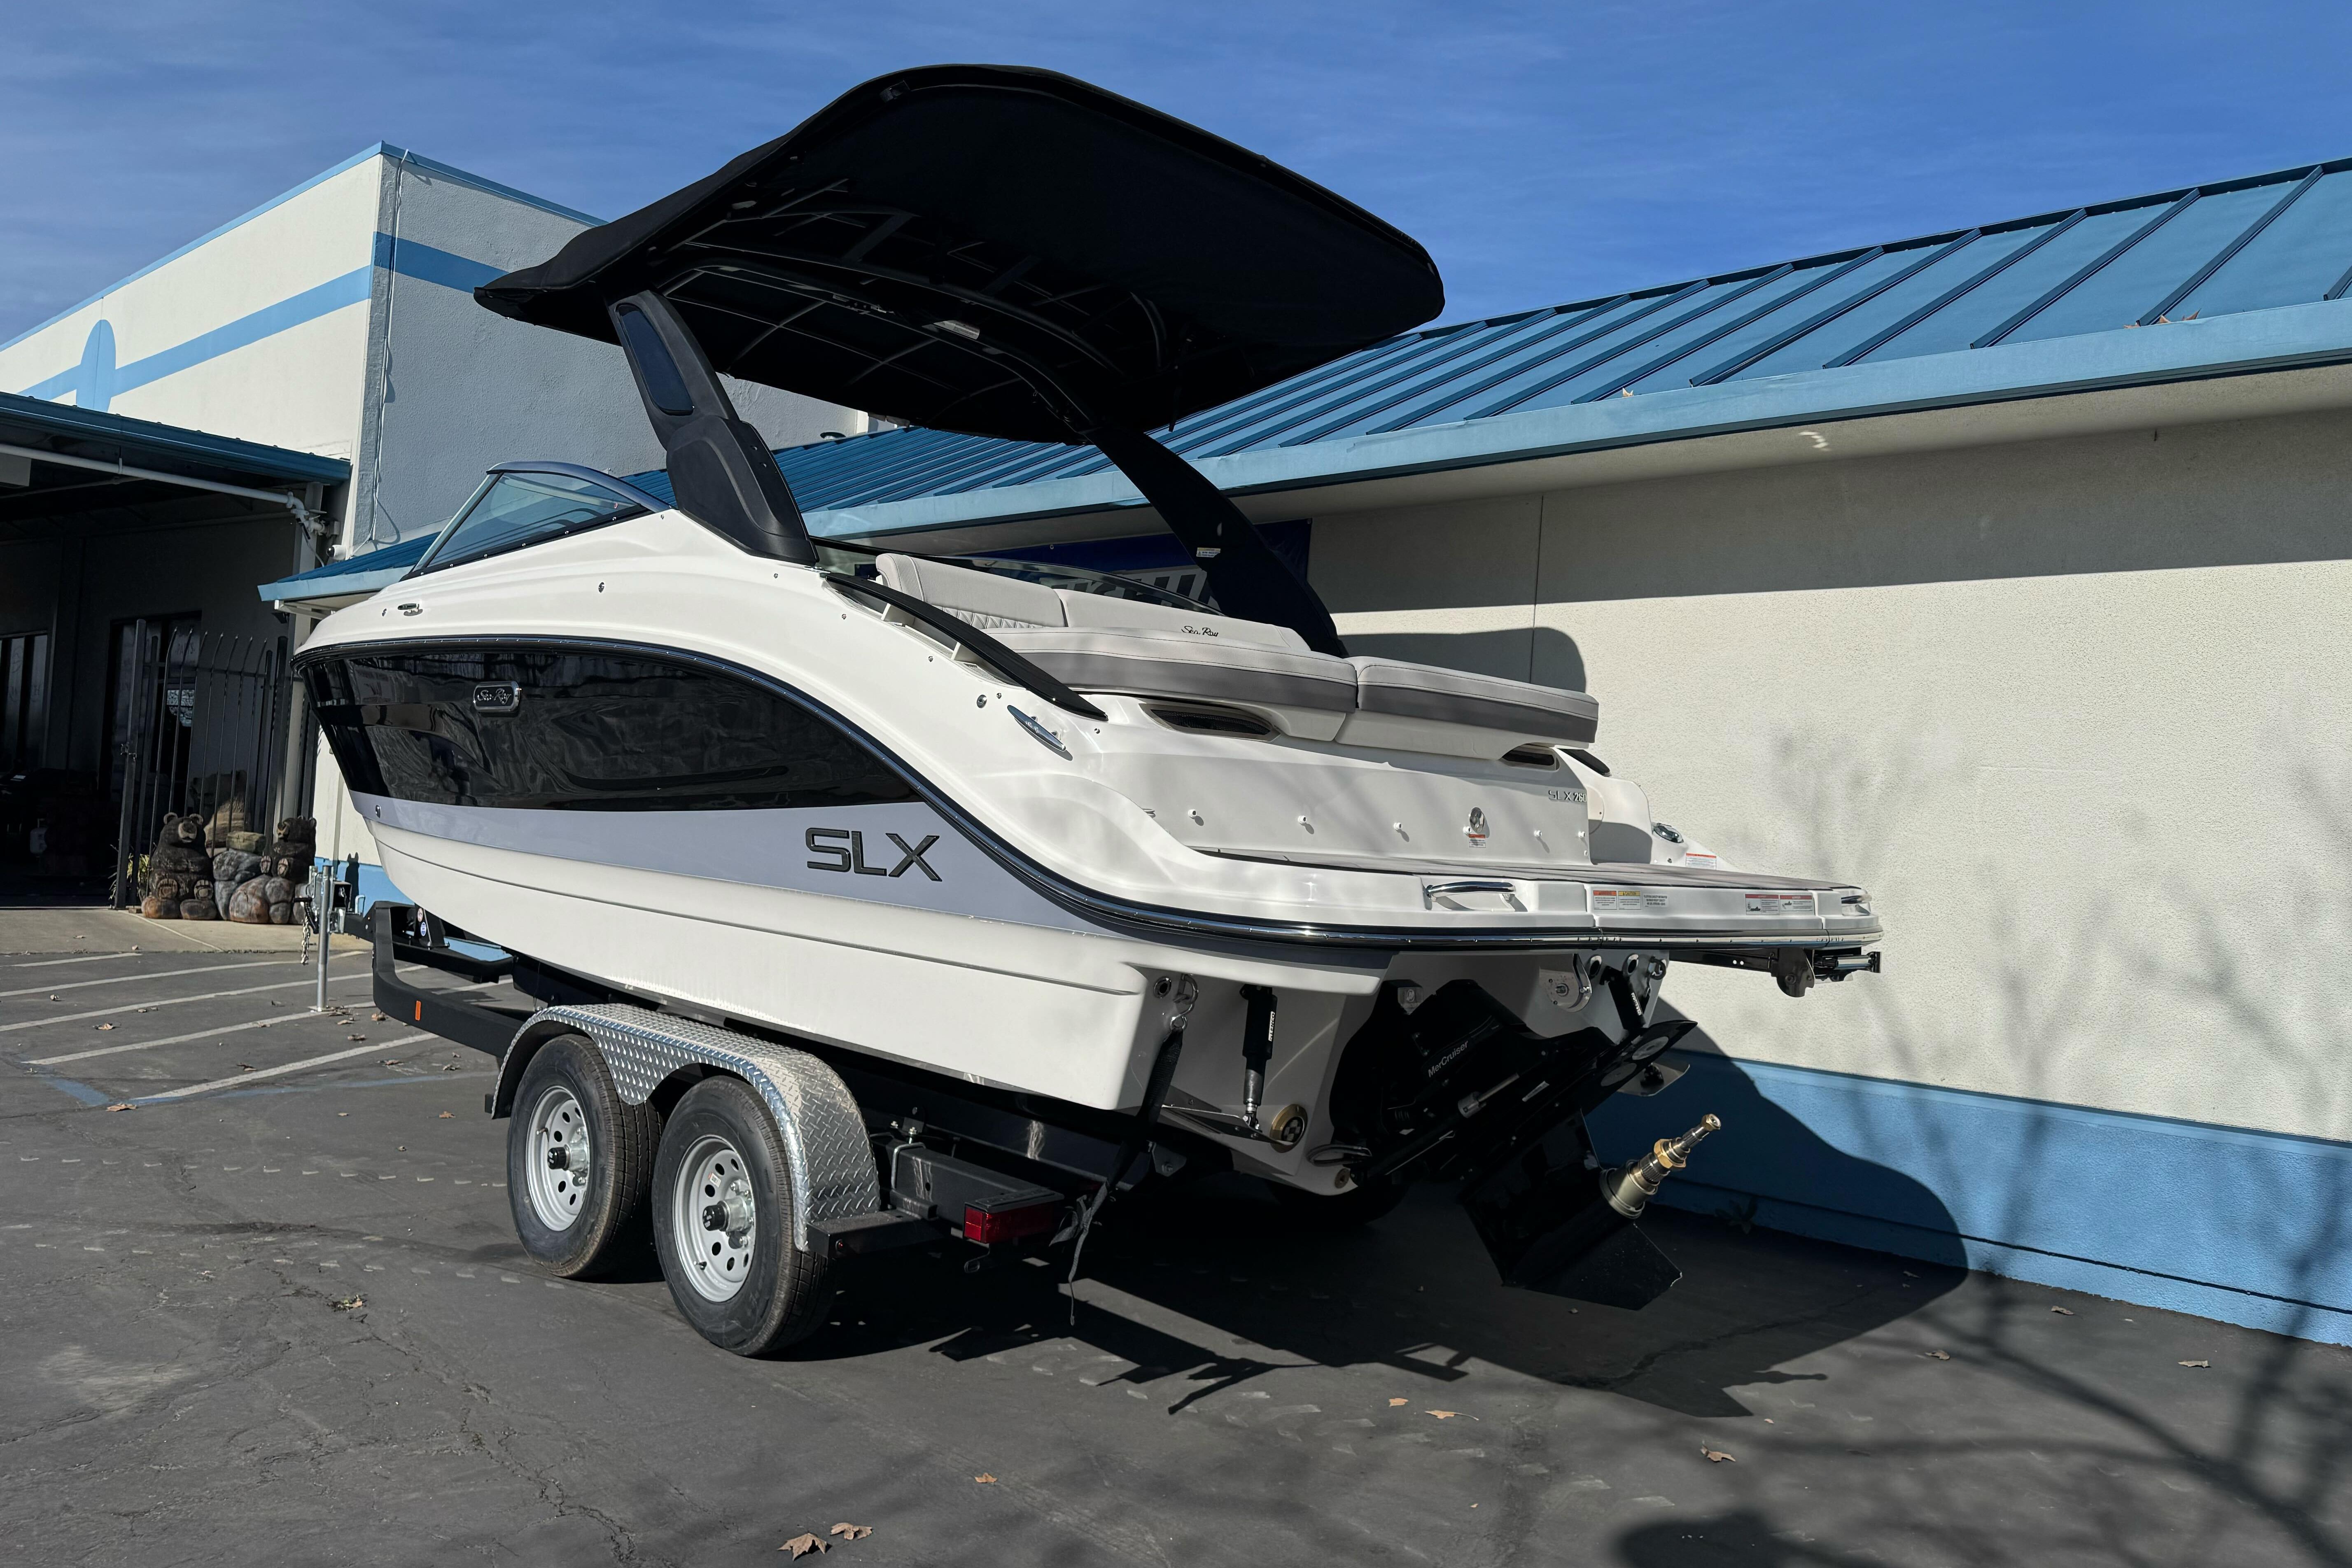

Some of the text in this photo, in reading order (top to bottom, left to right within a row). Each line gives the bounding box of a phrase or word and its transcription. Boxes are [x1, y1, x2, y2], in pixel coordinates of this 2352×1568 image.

[1181, 625, 1201, 635] Sea
[477, 688, 512, 705] Sea Ray
[1548, 789, 1587, 803] SLX 260
[805, 827, 943, 882] SLX
[1428, 1040, 1469, 1078] MerCruiser
